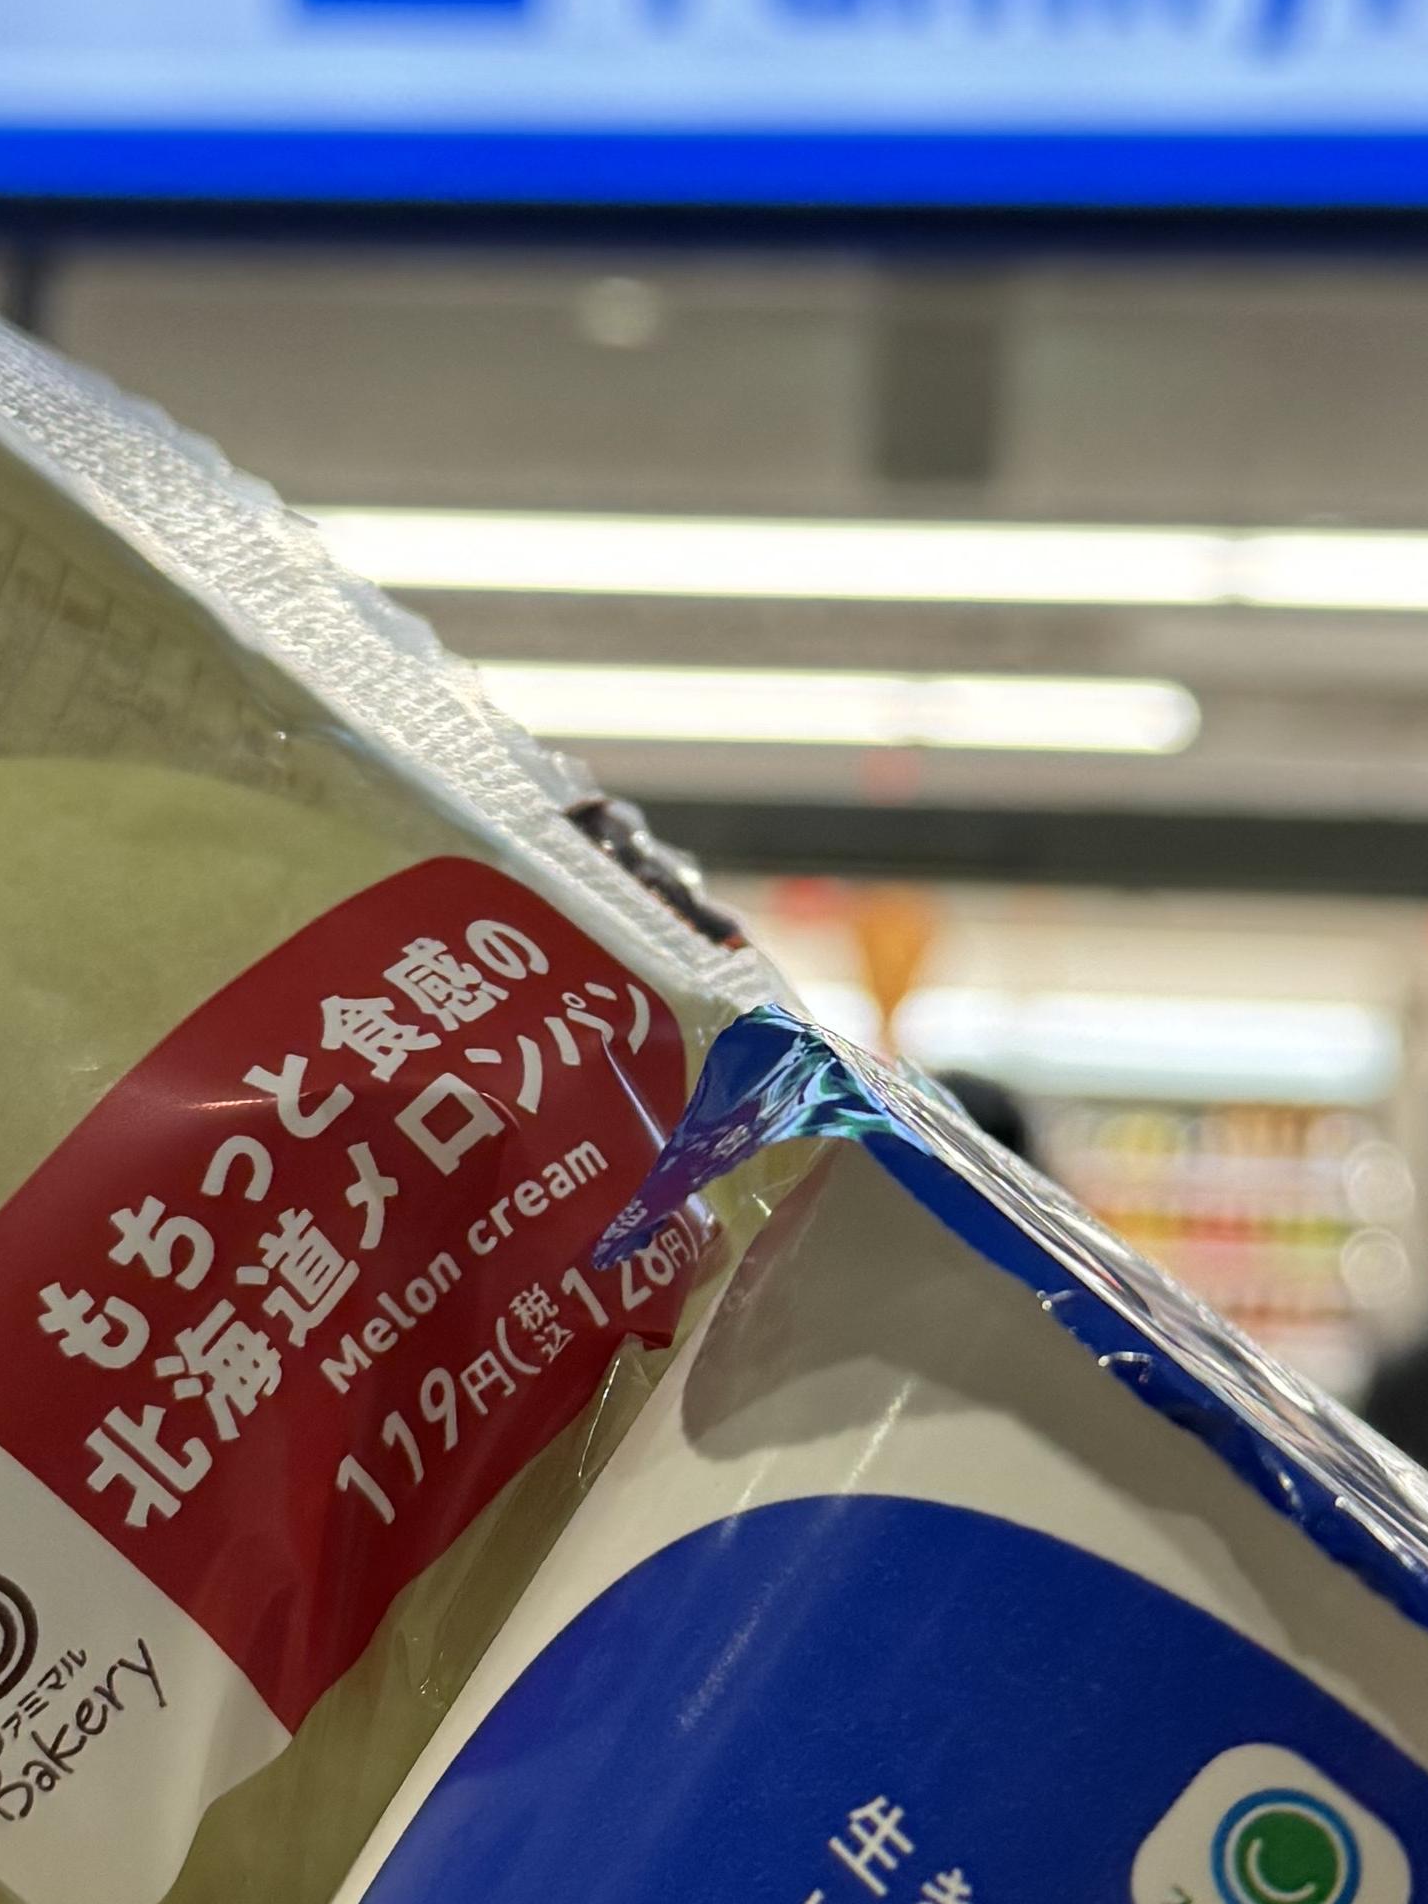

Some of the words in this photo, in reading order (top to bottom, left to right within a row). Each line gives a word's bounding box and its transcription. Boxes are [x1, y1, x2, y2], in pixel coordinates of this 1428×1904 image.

[38, 919, 549, 1369] もちっと食感の
[85, 982, 651, 1528] 北海道メロンパン
[320, 1251, 463, 1394] Melon
[466, 1139, 608, 1256] cream
